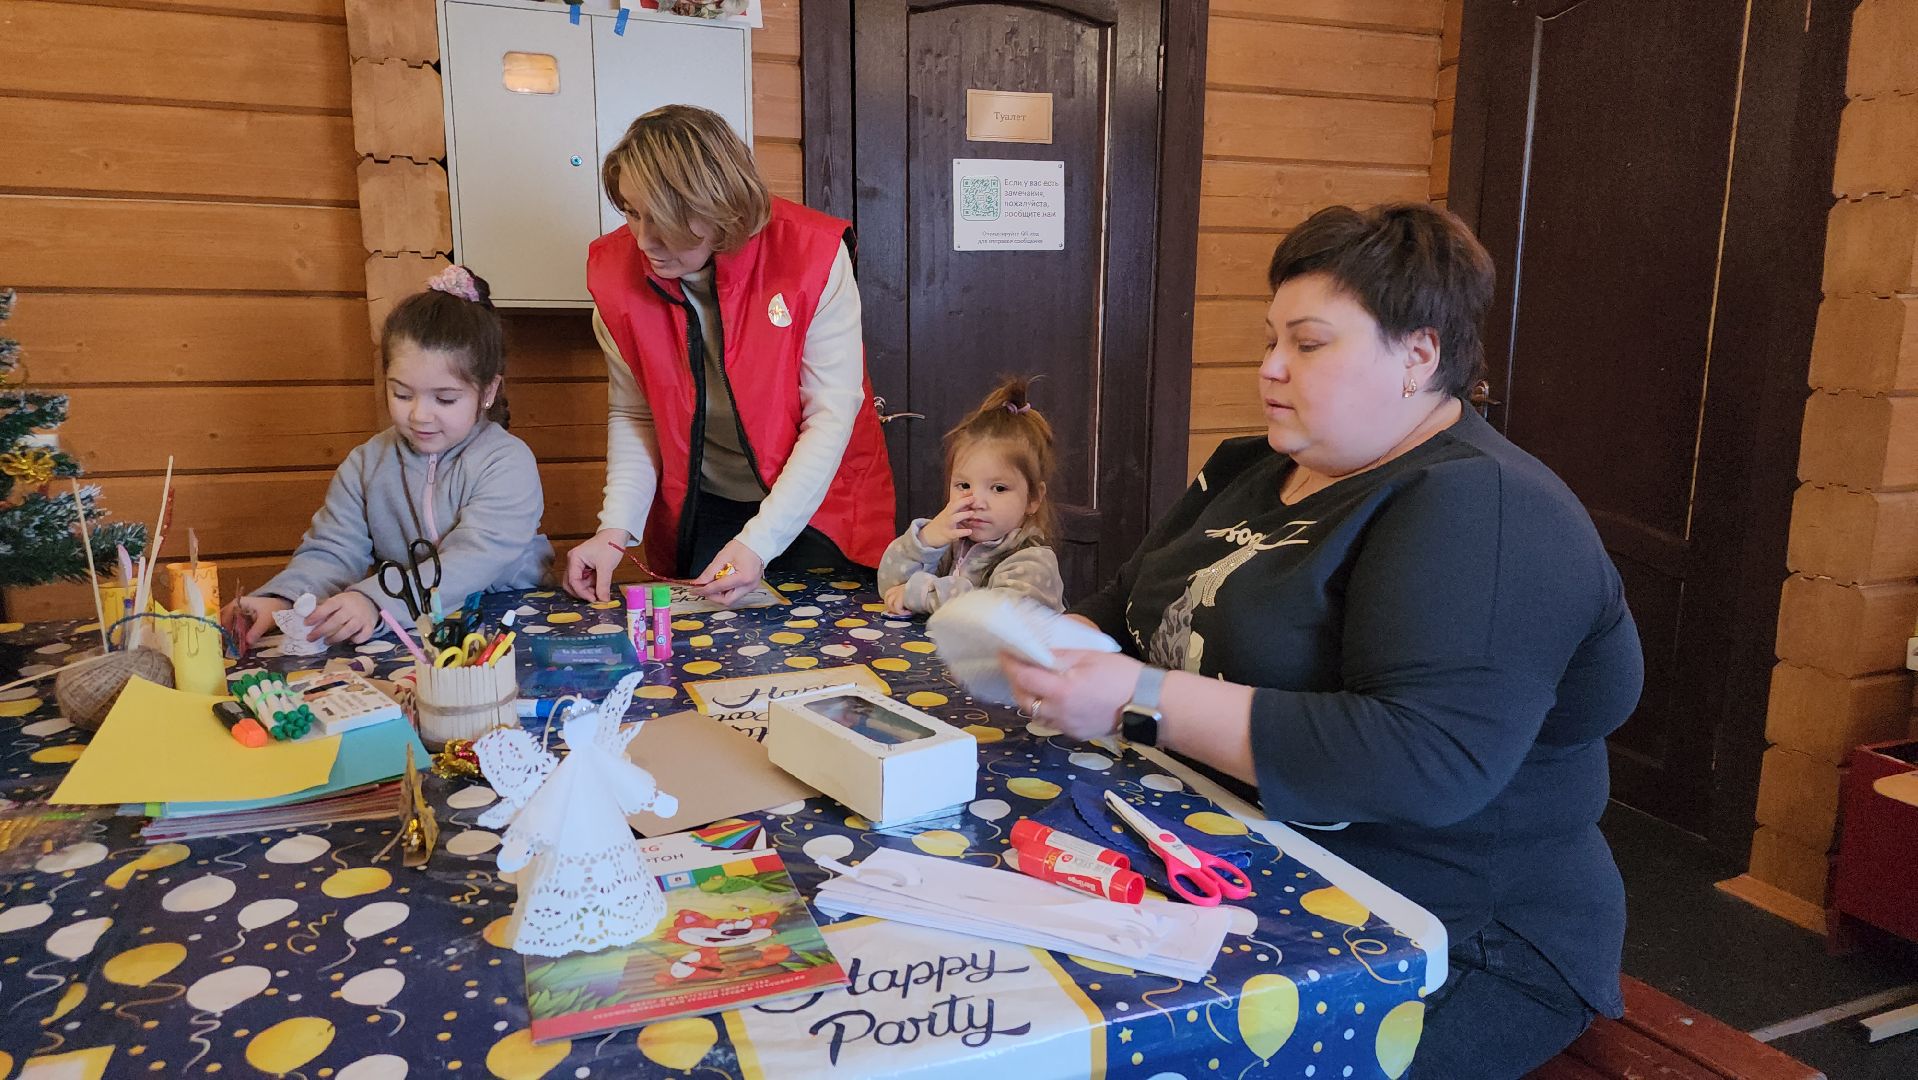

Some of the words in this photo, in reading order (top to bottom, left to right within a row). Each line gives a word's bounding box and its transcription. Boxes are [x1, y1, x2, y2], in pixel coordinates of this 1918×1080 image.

[993, 111, 1026, 123] Туалет
[1004, 178, 1022, 187] Если
[808, 995, 1032, 1067] Party
